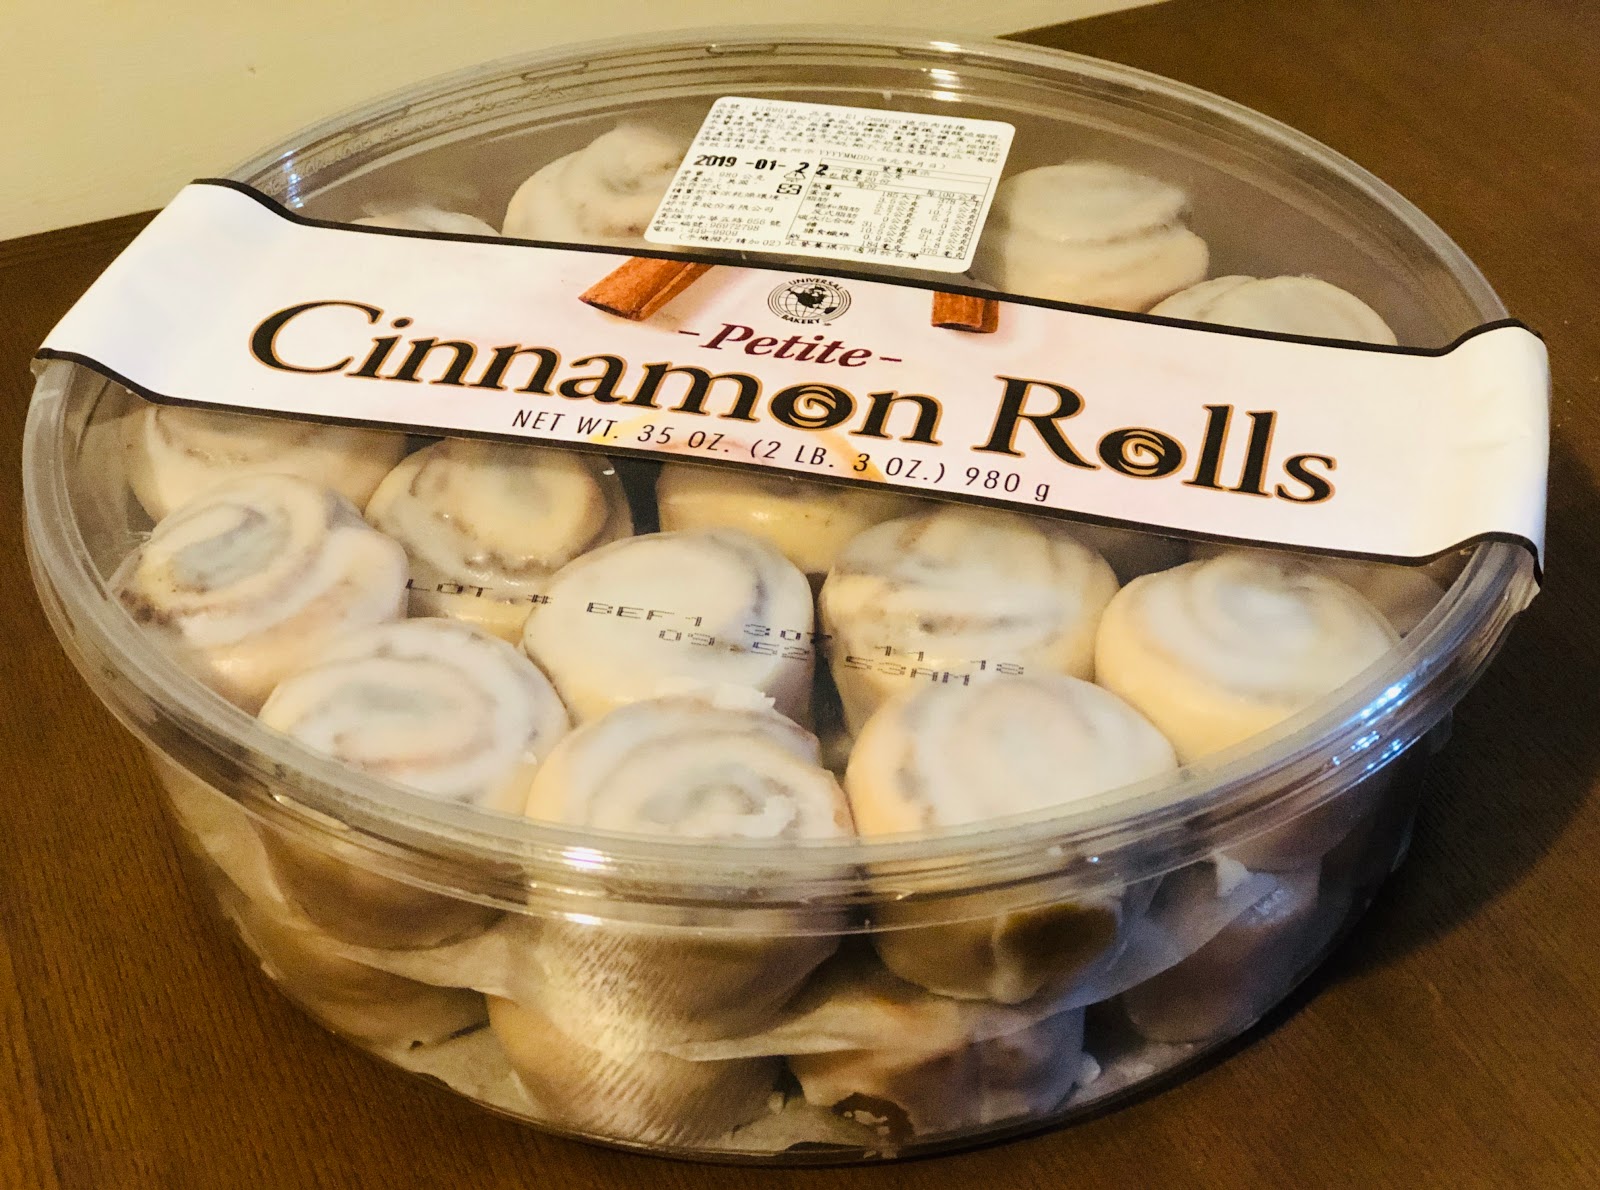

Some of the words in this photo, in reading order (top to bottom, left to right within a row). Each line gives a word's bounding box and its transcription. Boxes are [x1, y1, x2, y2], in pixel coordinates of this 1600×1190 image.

[693, 154, 738, 168] 2019
[788, 277, 843, 291] UNIVERSAL
[781, 314, 821, 325] BAKERY
[249, 299, 943, 447] Cinnamon
[971, 374, 1337, 504] Rolls
[511, 409, 565, 432] NET
[576, 415, 619, 440] WT.
[637, 424, 674, 445] 35
[687, 430, 730, 453] OZ.
[750, 438, 781, 460] (2
[794, 444, 835, 468] LB.
[852, 452, 870, 473] 3
[885, 456, 946, 484] OZ.)
[965, 466, 1021, 494] 980
[1034, 482, 1051, 503] g
[405, 578, 494, 598] LOT
